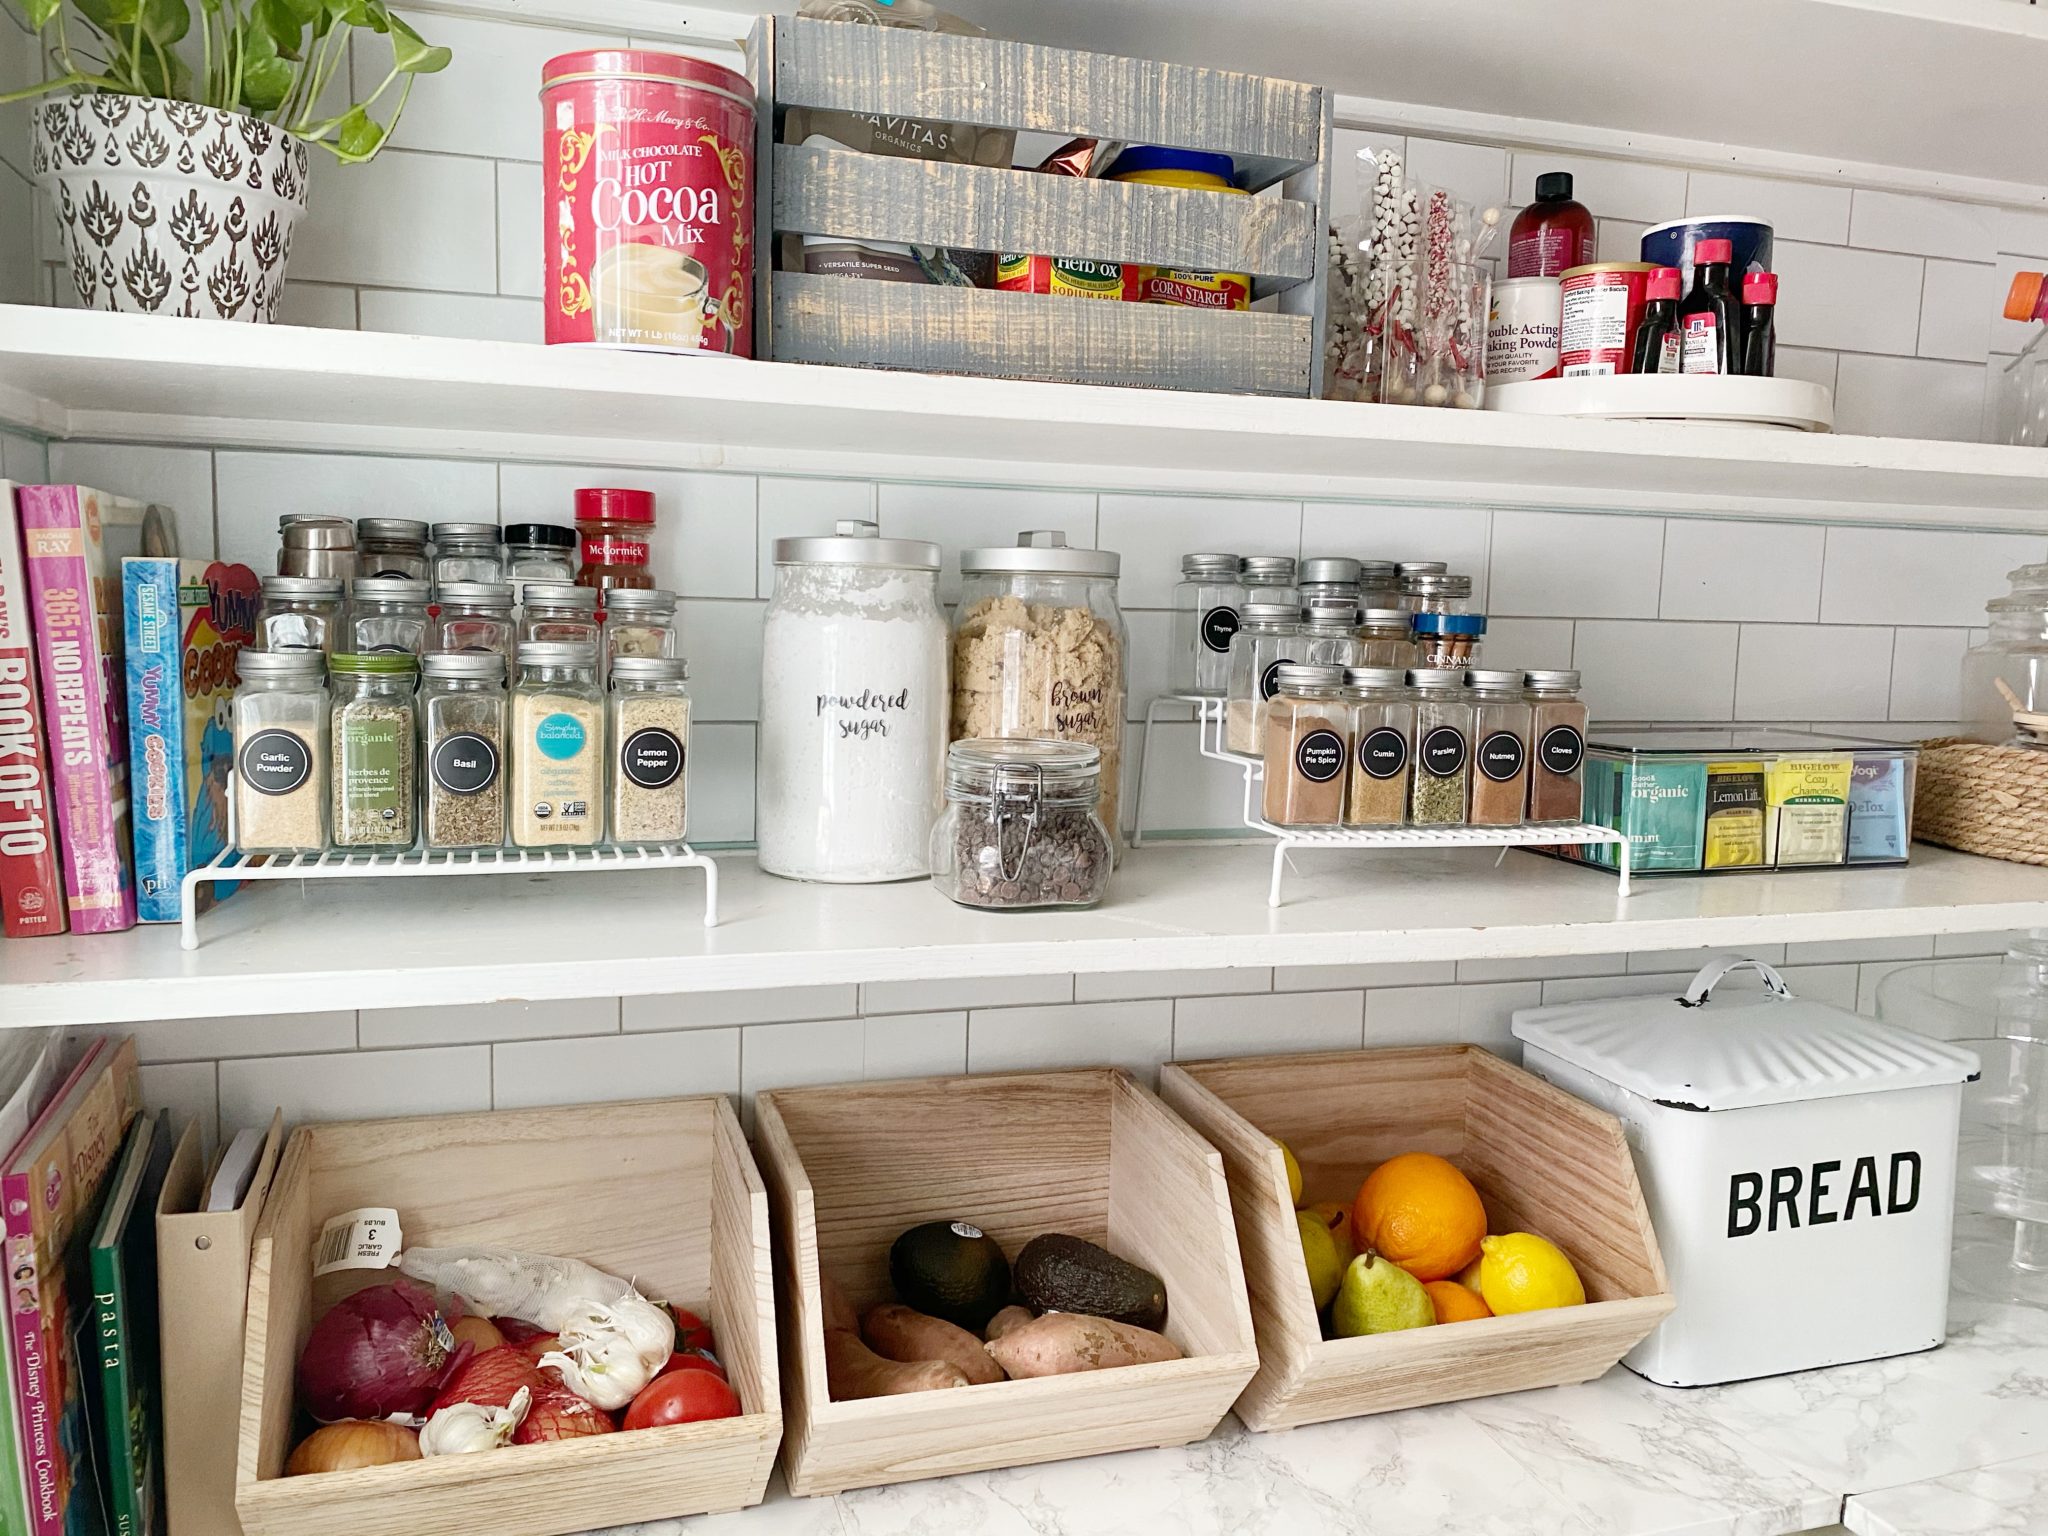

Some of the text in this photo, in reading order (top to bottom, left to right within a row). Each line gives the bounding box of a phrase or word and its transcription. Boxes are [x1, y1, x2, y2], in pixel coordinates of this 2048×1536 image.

[875, 131, 922, 153] ORGANICS
[600, 144, 703, 161] MILK CHOCOLATE
[624, 160, 673, 187] HOT
[591, 178, 721, 232] Cocoa
[661, 223, 705, 247] Mix
[823, 261, 900, 273] VERSATILE SUPER SEED
[1058, 258, 1095, 274] Herb
[1174, 272, 1215, 283] 100% PURE
[1052, 286, 1094, 299] SODIUM
[1150, 279, 1183, 298] CORN
[1185, 286, 1228, 306] STARCH
[608, 327, 627, 338] NET
[627, 328, 643, 338] WT
[1488, 322, 1559, 341] ouble Acting
[1487, 337, 1558, 354] aking Powde
[38, 541, 73, 553] RAY
[589, 544, 642, 557] McCormick
[141, 587, 157, 653] SESAME STREET
[1213, 625, 1233, 633] Thyme
[43, 588, 93, 766] 365: NO REPEATS
[183, 642, 242, 699] COOK
[141, 664, 164, 729] YUMMY
[1051, 681, 1102, 705] brown
[816, 687, 911, 718] powdered
[544, 722, 579, 733] Simply
[1056, 710, 1101, 733] sugar
[838, 717, 892, 743] sugar
[348, 732, 394, 746] organic
[637, 748, 668, 758] Lemon
[1306, 747, 1336, 757] Pumpkin
[1373, 750, 1395, 758] Cumin
[1432, 747, 1456, 756] Parsley
[1551, 746, 1573, 754] Cloves
[260, 752, 290, 762] Garlic
[453, 758, 477, 769] Basil
[1318, 757, 1337, 765] Spice
[1489, 753, 1515, 761] Nutmeg
[256, 763, 294, 774] Powder
[636, 758, 668, 770] Pepper
[1790, 763, 1840, 771] BIGELOW
[144, 734, 167, 821] COOKIES
[348, 768, 390, 776] herbes de
[348, 776, 389, 785] provence
[1716, 775, 1755, 783] BIGELOW
[1804, 774, 1828, 786] Cozy
[1631, 785, 1689, 803] organic
[1713, 788, 1760, 803] Lemon Lift
[1791, 784, 1840, 796] Chamomile
[0, 814, 47, 857] 10
[1630, 832, 1660, 843] mint
[19, 916, 47, 925] POTTER
[1727, 1150, 1922, 1239] BREAD
[368, 1229, 377, 1241] 3
[94, 1292, 120, 1369] pasta
[23, 1331, 55, 1522] The Disney Princess Cookbook
